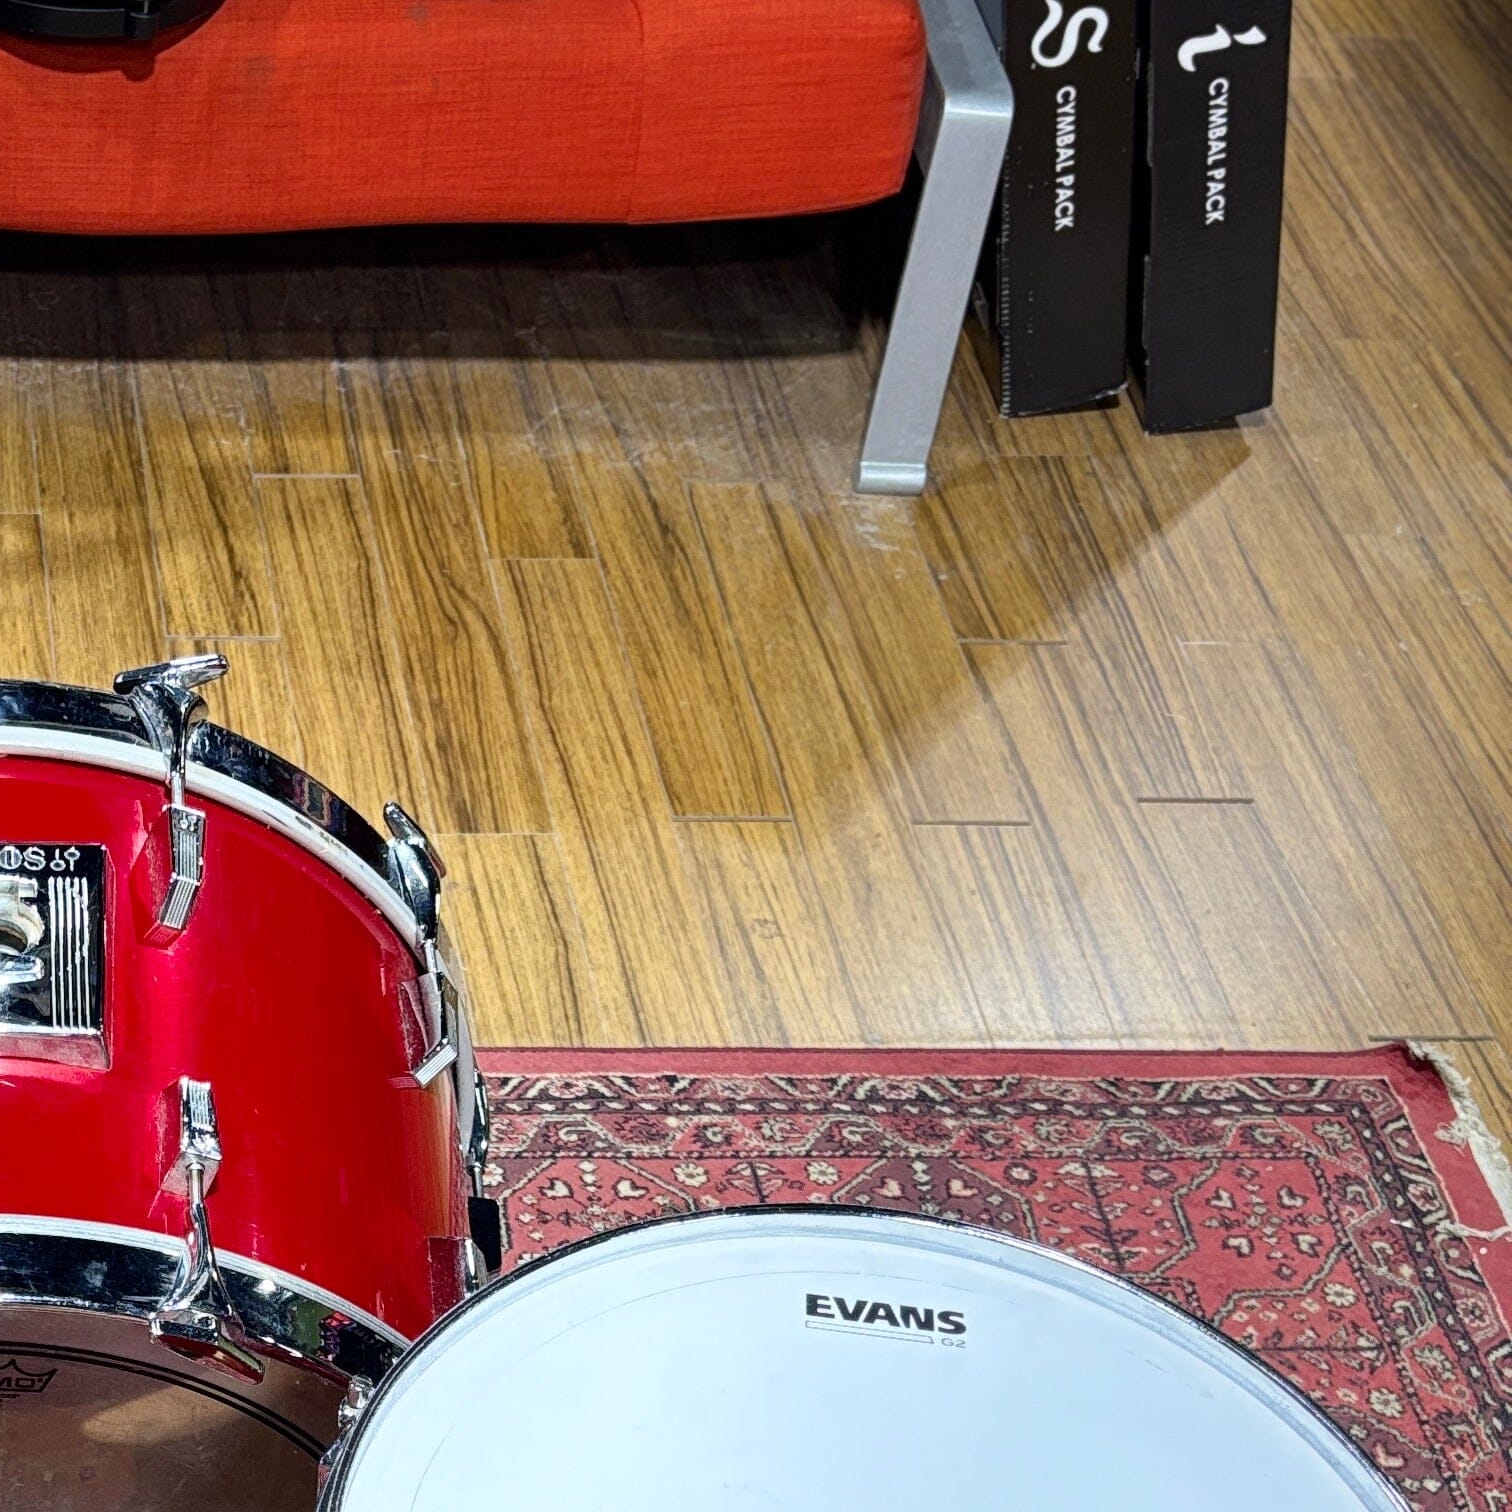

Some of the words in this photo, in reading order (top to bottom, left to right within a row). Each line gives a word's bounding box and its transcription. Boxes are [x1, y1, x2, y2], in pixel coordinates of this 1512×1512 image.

[1055, 86, 1077, 172] CYMBAL
[1207, 78, 1230, 165] CYMBAL
[1054, 174, 1075, 231] PACK
[1205, 167, 1227, 225] PACK
[806, 1293, 967, 1335] EVANS
[941, 1337, 967, 1349] G2
